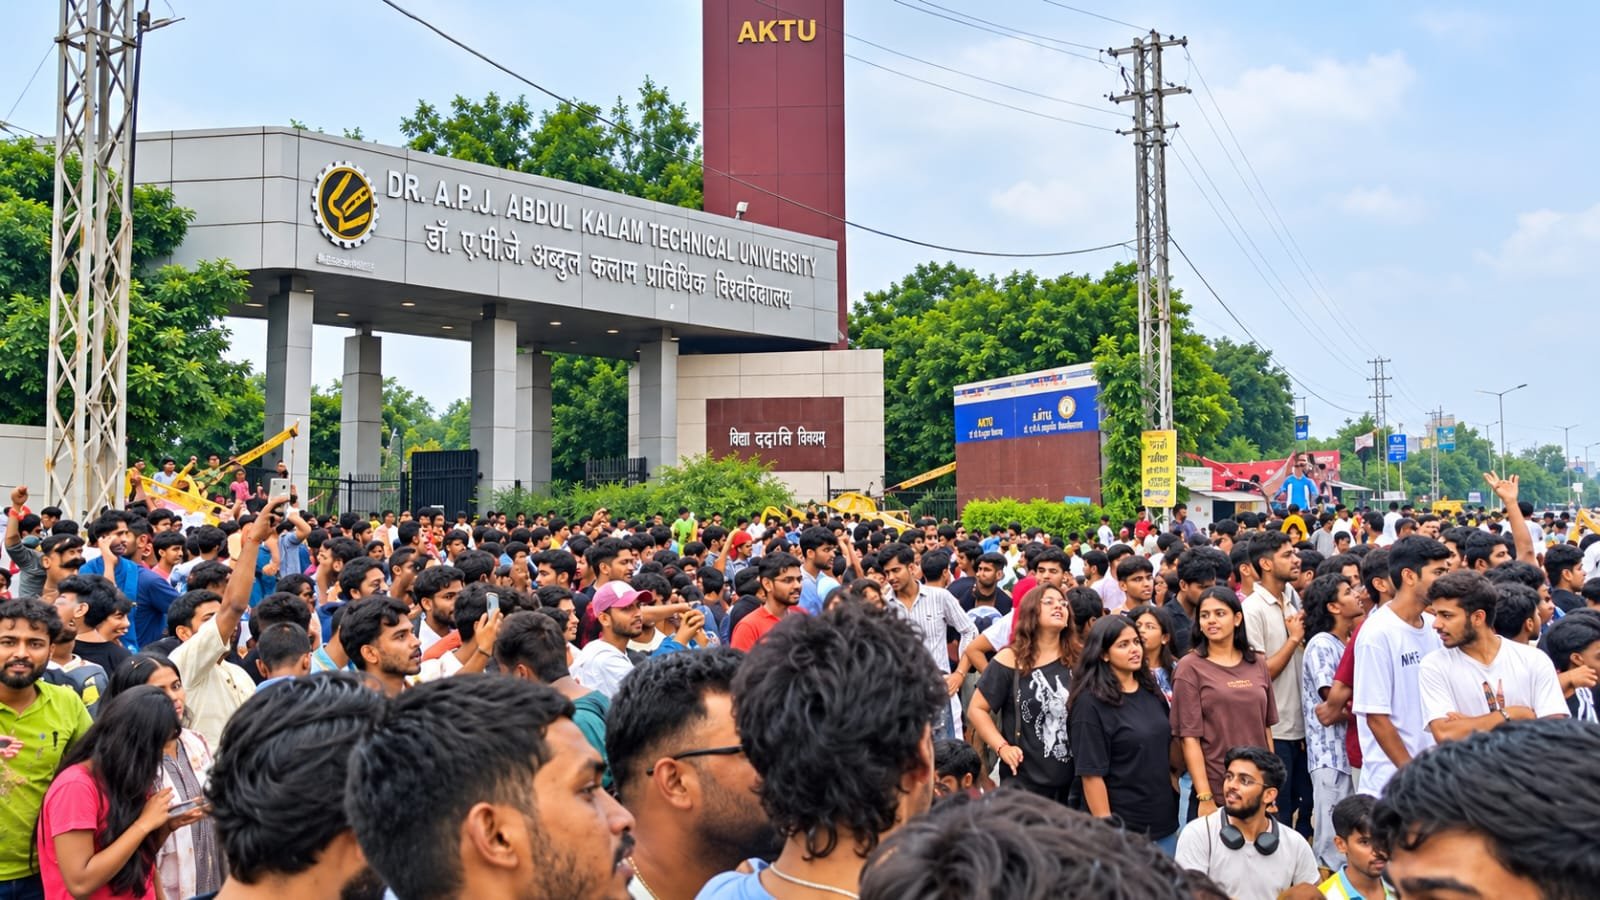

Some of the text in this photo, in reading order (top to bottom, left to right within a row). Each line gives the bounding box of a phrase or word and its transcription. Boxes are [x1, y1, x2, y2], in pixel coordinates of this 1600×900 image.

[737, 19, 816, 43] AKTU
[387, 169, 817, 278] DR. A.P.J. ABDUL KALAM TECHNICAL UNIVERSITY
[424, 219, 452, 255] डॉ.
[460, 226, 525, 265] ए.पी.जे.
[531, 243, 582, 282] अब्दुल
[590, 253, 638, 285] कलाम
[645, 258, 707, 295] प्राविधिक
